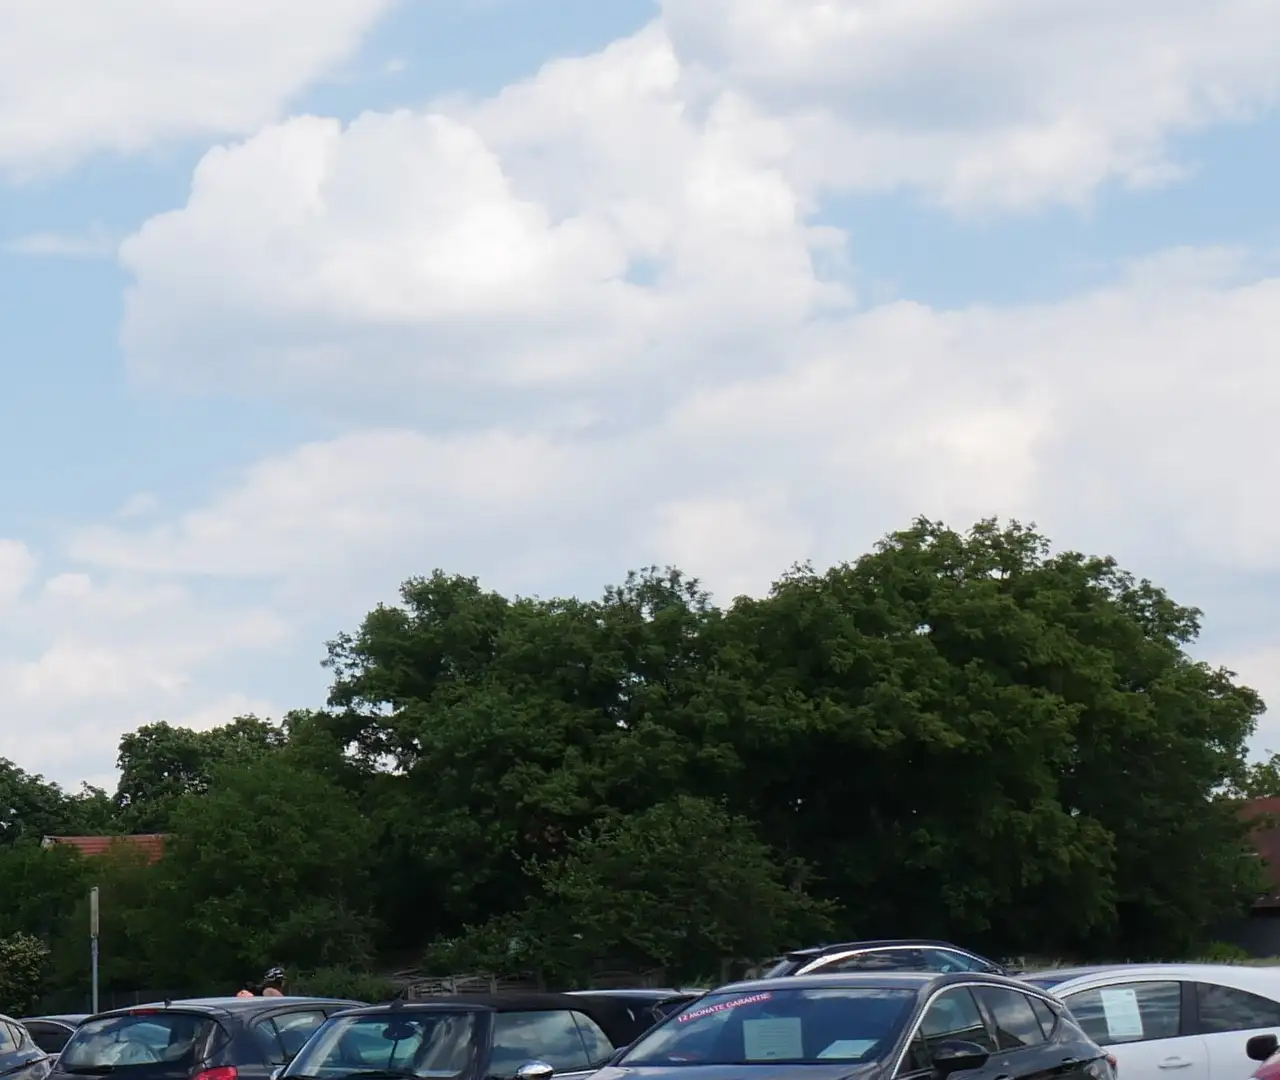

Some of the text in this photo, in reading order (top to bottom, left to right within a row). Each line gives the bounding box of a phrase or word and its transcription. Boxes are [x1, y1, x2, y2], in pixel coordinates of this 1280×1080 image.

[677, 992, 771, 1022] 12 MONATE GARANTIE
